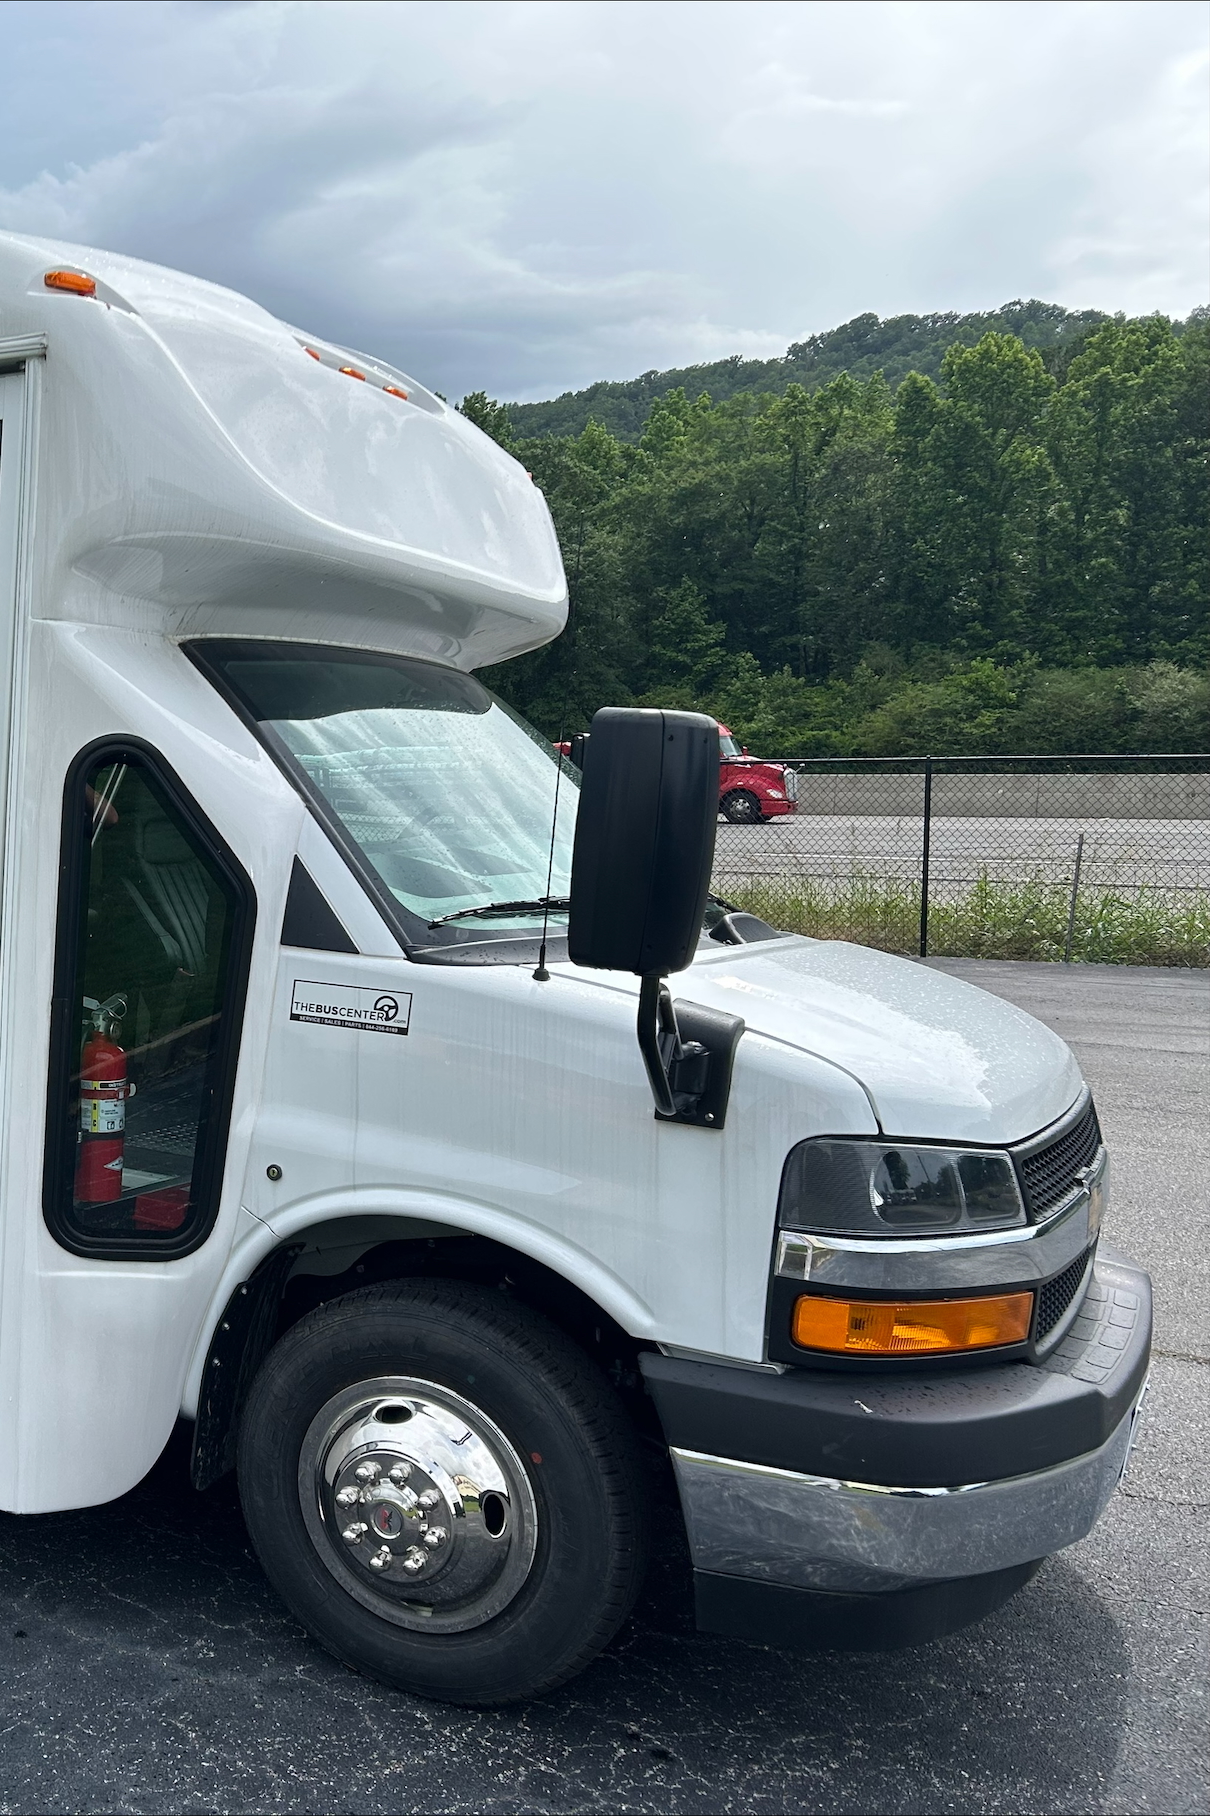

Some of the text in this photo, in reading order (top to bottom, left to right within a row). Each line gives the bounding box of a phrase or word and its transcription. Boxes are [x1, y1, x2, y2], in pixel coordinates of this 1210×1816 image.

[294, 1001, 386, 1022] THEBUSCENTER
[299, 1015, 321, 1024] SERVICE
[324, 1017, 342, 1026] SALES
[344, 1021, 362, 1029] PARTS
